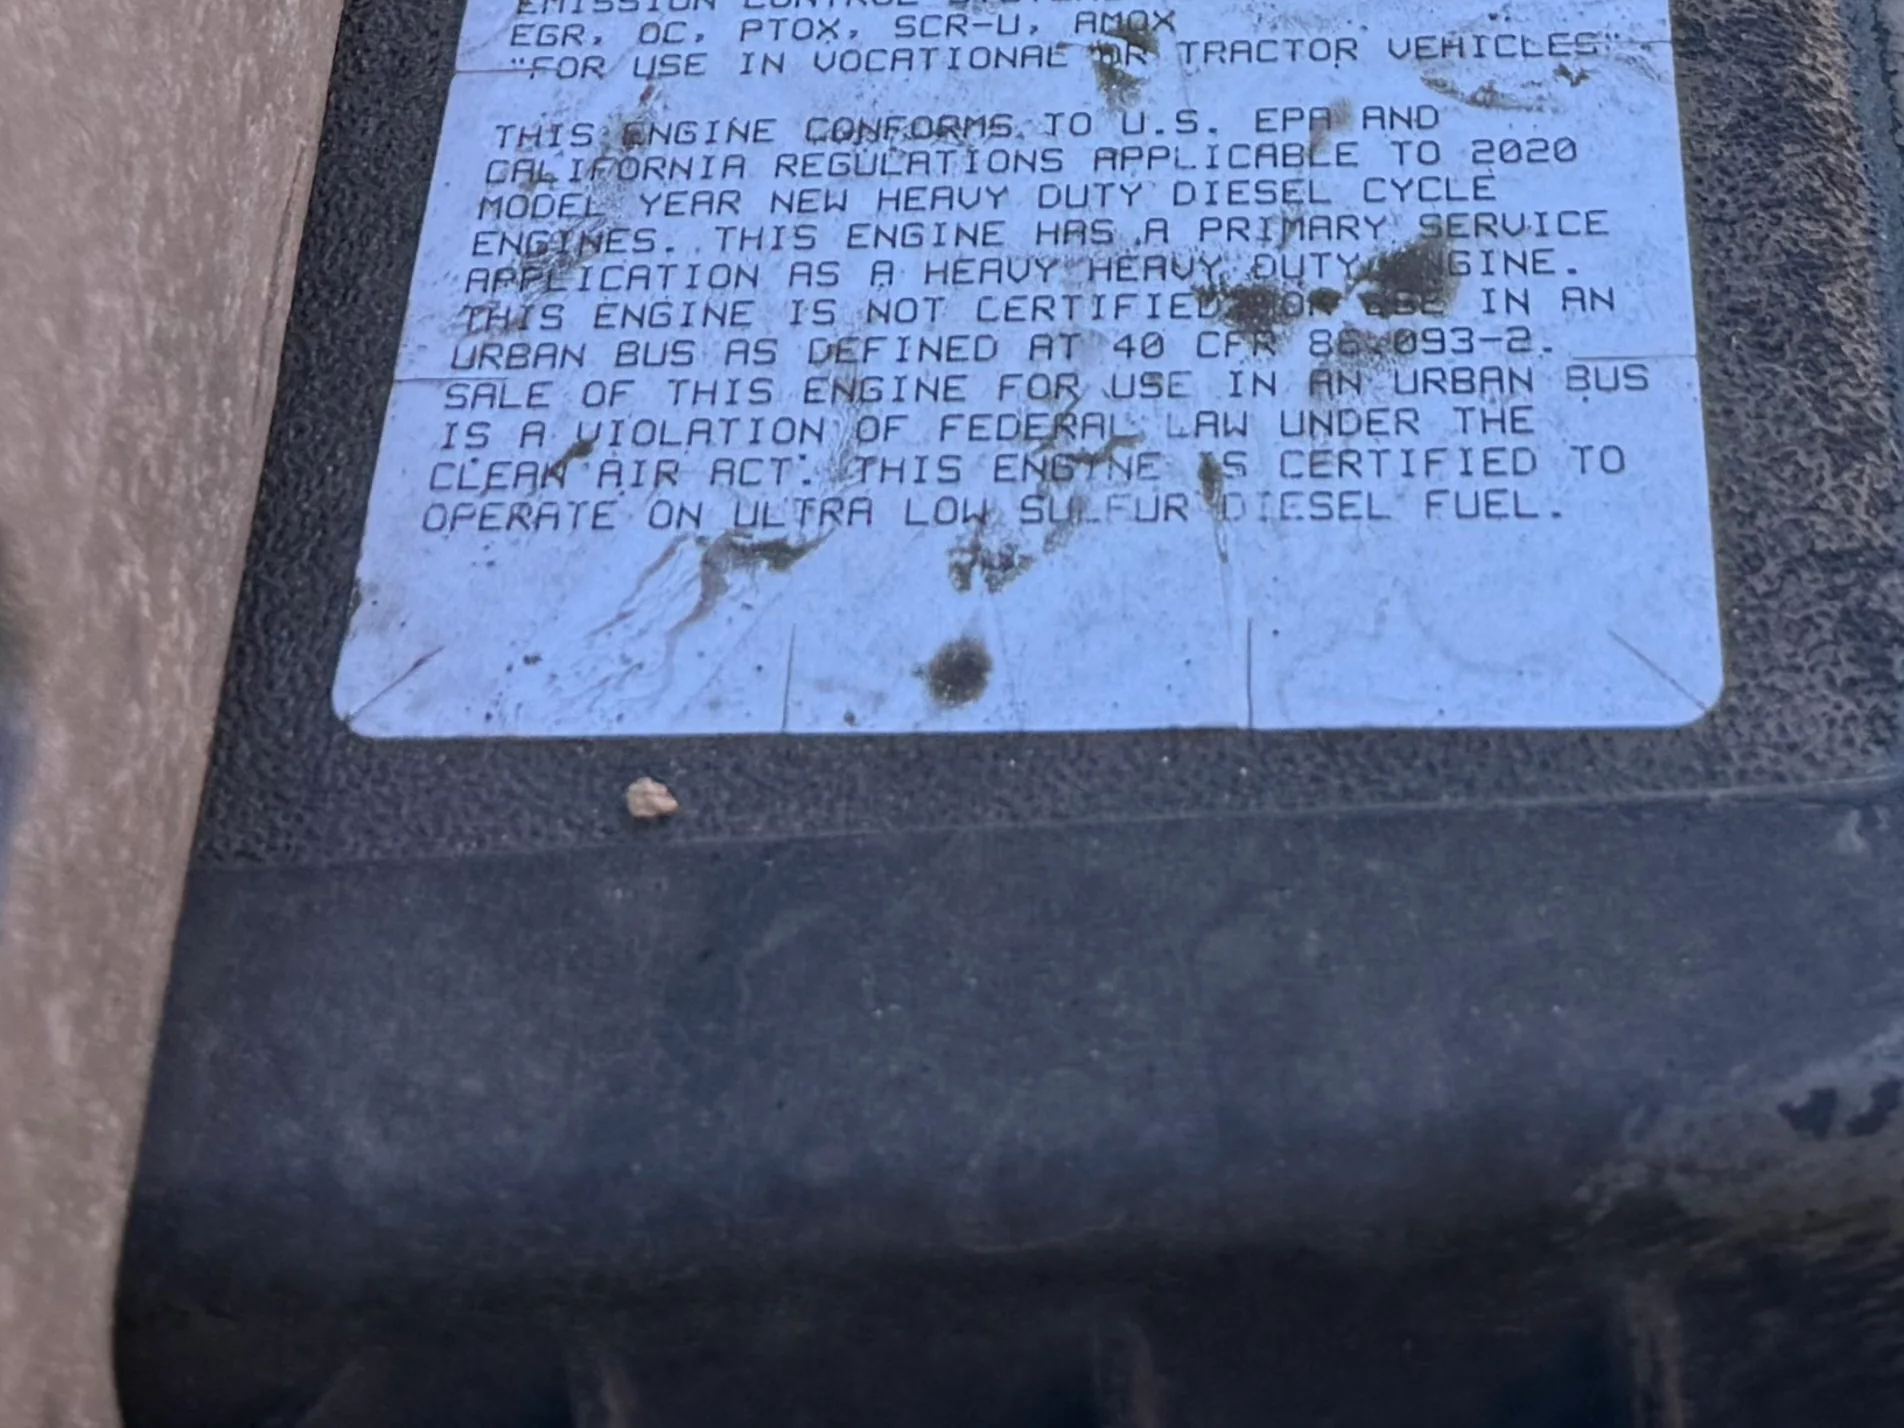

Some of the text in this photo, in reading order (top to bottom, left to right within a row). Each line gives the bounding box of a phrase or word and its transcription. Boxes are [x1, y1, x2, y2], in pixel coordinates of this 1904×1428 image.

[509, 9, 1176, 47] EGR, OC, PTOX, SCR-U, AMOX
[631, 52, 709, 77] USE
[737, 51, 786, 74] IN
[811, 44, 1070, 73] VOCATIONAL
[1178, 38, 1359, 65] TRACTOR
[492, 104, 1441, 148] THIS ENGINE CONFORMS TO U.S. EPA AND
[483, 136, 1578, 183] CALIFORNIA REGULATIONS APPLICABLE TO 2020
[477, 175, 1497, 219] MODEL YEAR NEW HEAVY DUTY DIESEL CYCLE
[470, 209, 1610, 255] ENGINES. THIS ENGINE HAS A PRIMARY SERVICE
[464, 262, 760, 293] APPLICATION
[786, 260, 841, 287] AS
[867, 259, 895, 286] A
[922, 257, 1058, 285] HEAVY
[1086, 254, 1222, 282] HEAVY
[1251, 251, 1360, 279] DUTY
[459, 302, 567, 330] THIS
[592, 299, 756, 328] ENGINE
[786, 298, 837, 325] IS
[864, 296, 946, 324] NOT
[974, 292, 1222, 322] CERTIFIED
[1479, 287, 1530, 315] IN
[1560, 286, 1616, 314] AN
[449, 340, 587, 370] URBAN
[612, 339, 695, 367] BUS
[722, 338, 777, 366] AS
[804, 334, 997, 364] DEFINED
[1026, 333, 1081, 361] AT
[1109, 331, 1164, 360] 40
[1193, 330, 1276, 359] CFR
[442, 364, 1648, 409] SALE OF THIS ENGINE FOR USE IN AN URBAN BUS
[439, 406, 1535, 449] IS A VIOLATION OF FEDERAL LAW UNDER THE
[428, 445, 1625, 490] CLEAN AIR ACT. THIS ENGINE S CERTIFIED TO
[420, 500, 618, 531] OPERATE
[645, 499, 703, 529] ON
[730, 497, 873, 528] ULTRA
[901, 496, 987, 526] LOW
[1218, 491, 1391, 522] DIESEL
[1422, 490, 1558, 519] FUEL.
